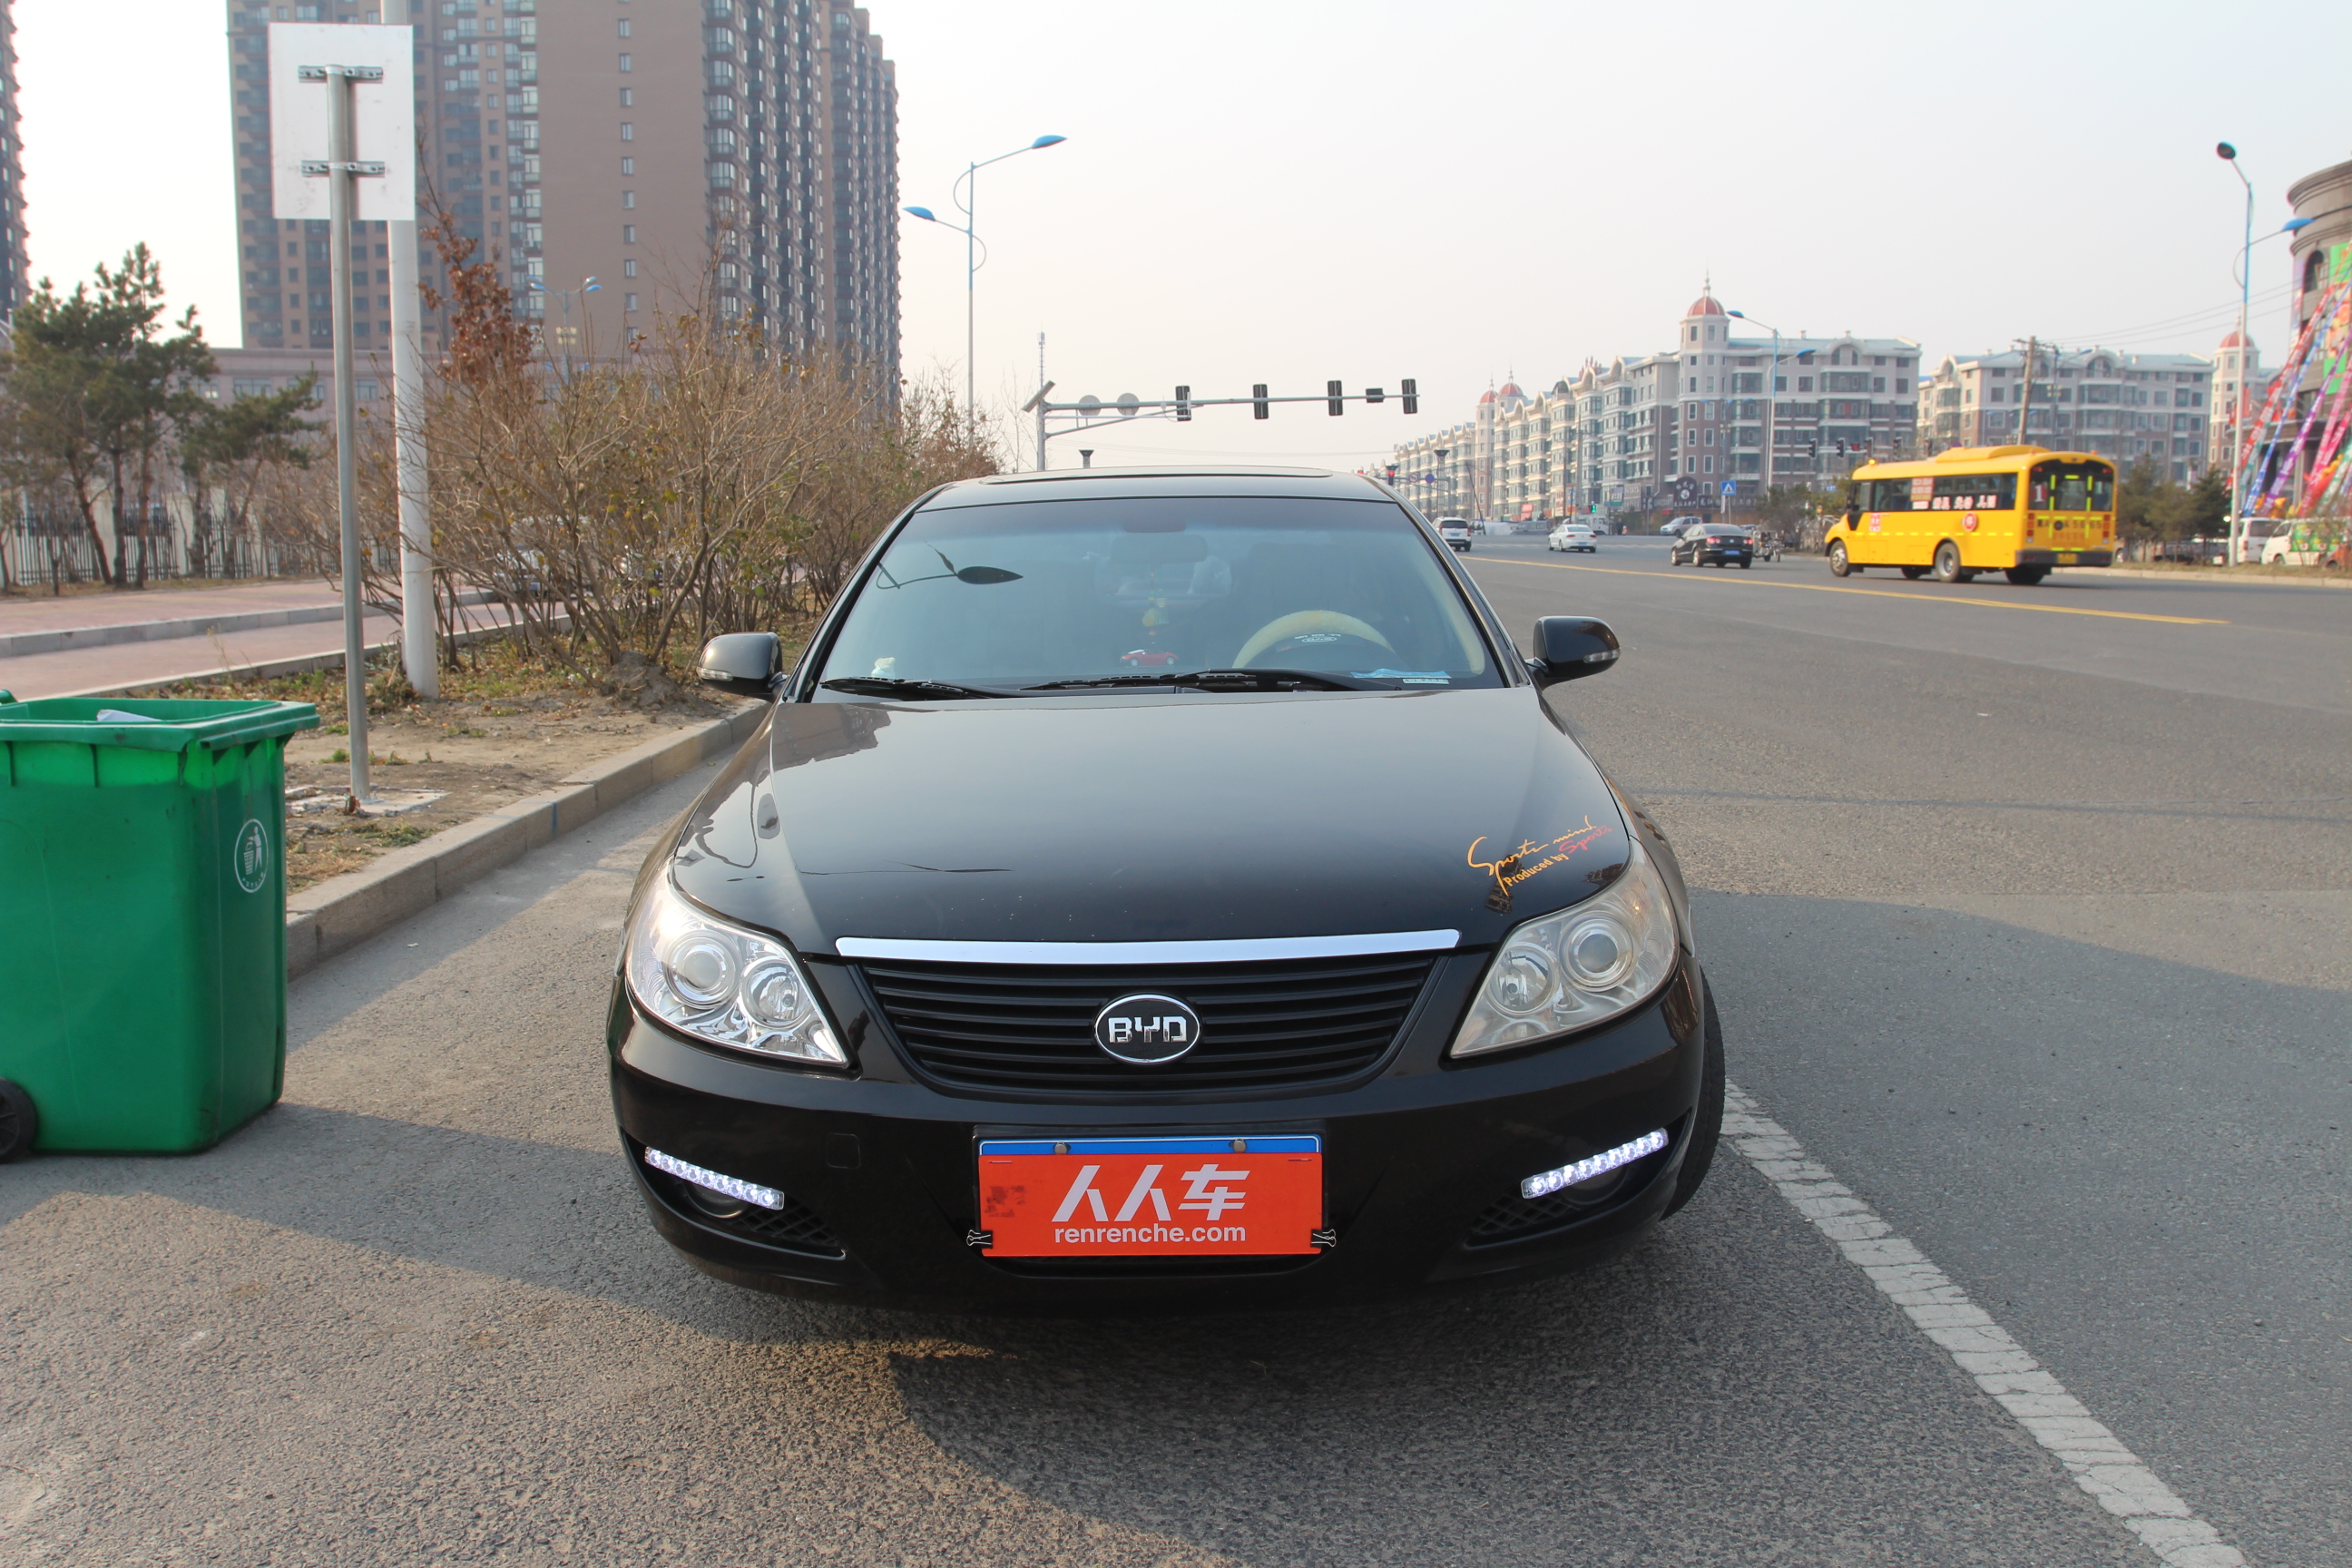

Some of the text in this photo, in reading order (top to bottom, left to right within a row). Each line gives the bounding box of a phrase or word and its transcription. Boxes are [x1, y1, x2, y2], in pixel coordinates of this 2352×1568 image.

[2034, 485, 2044, 503] 1
[1503, 824, 1614, 887] Produced by Sports
[1108, 1015, 1187, 1044] BYD
[1052, 1163, 1250, 1222] 人人车
[1054, 1222, 1246, 1243] renrenche.com
